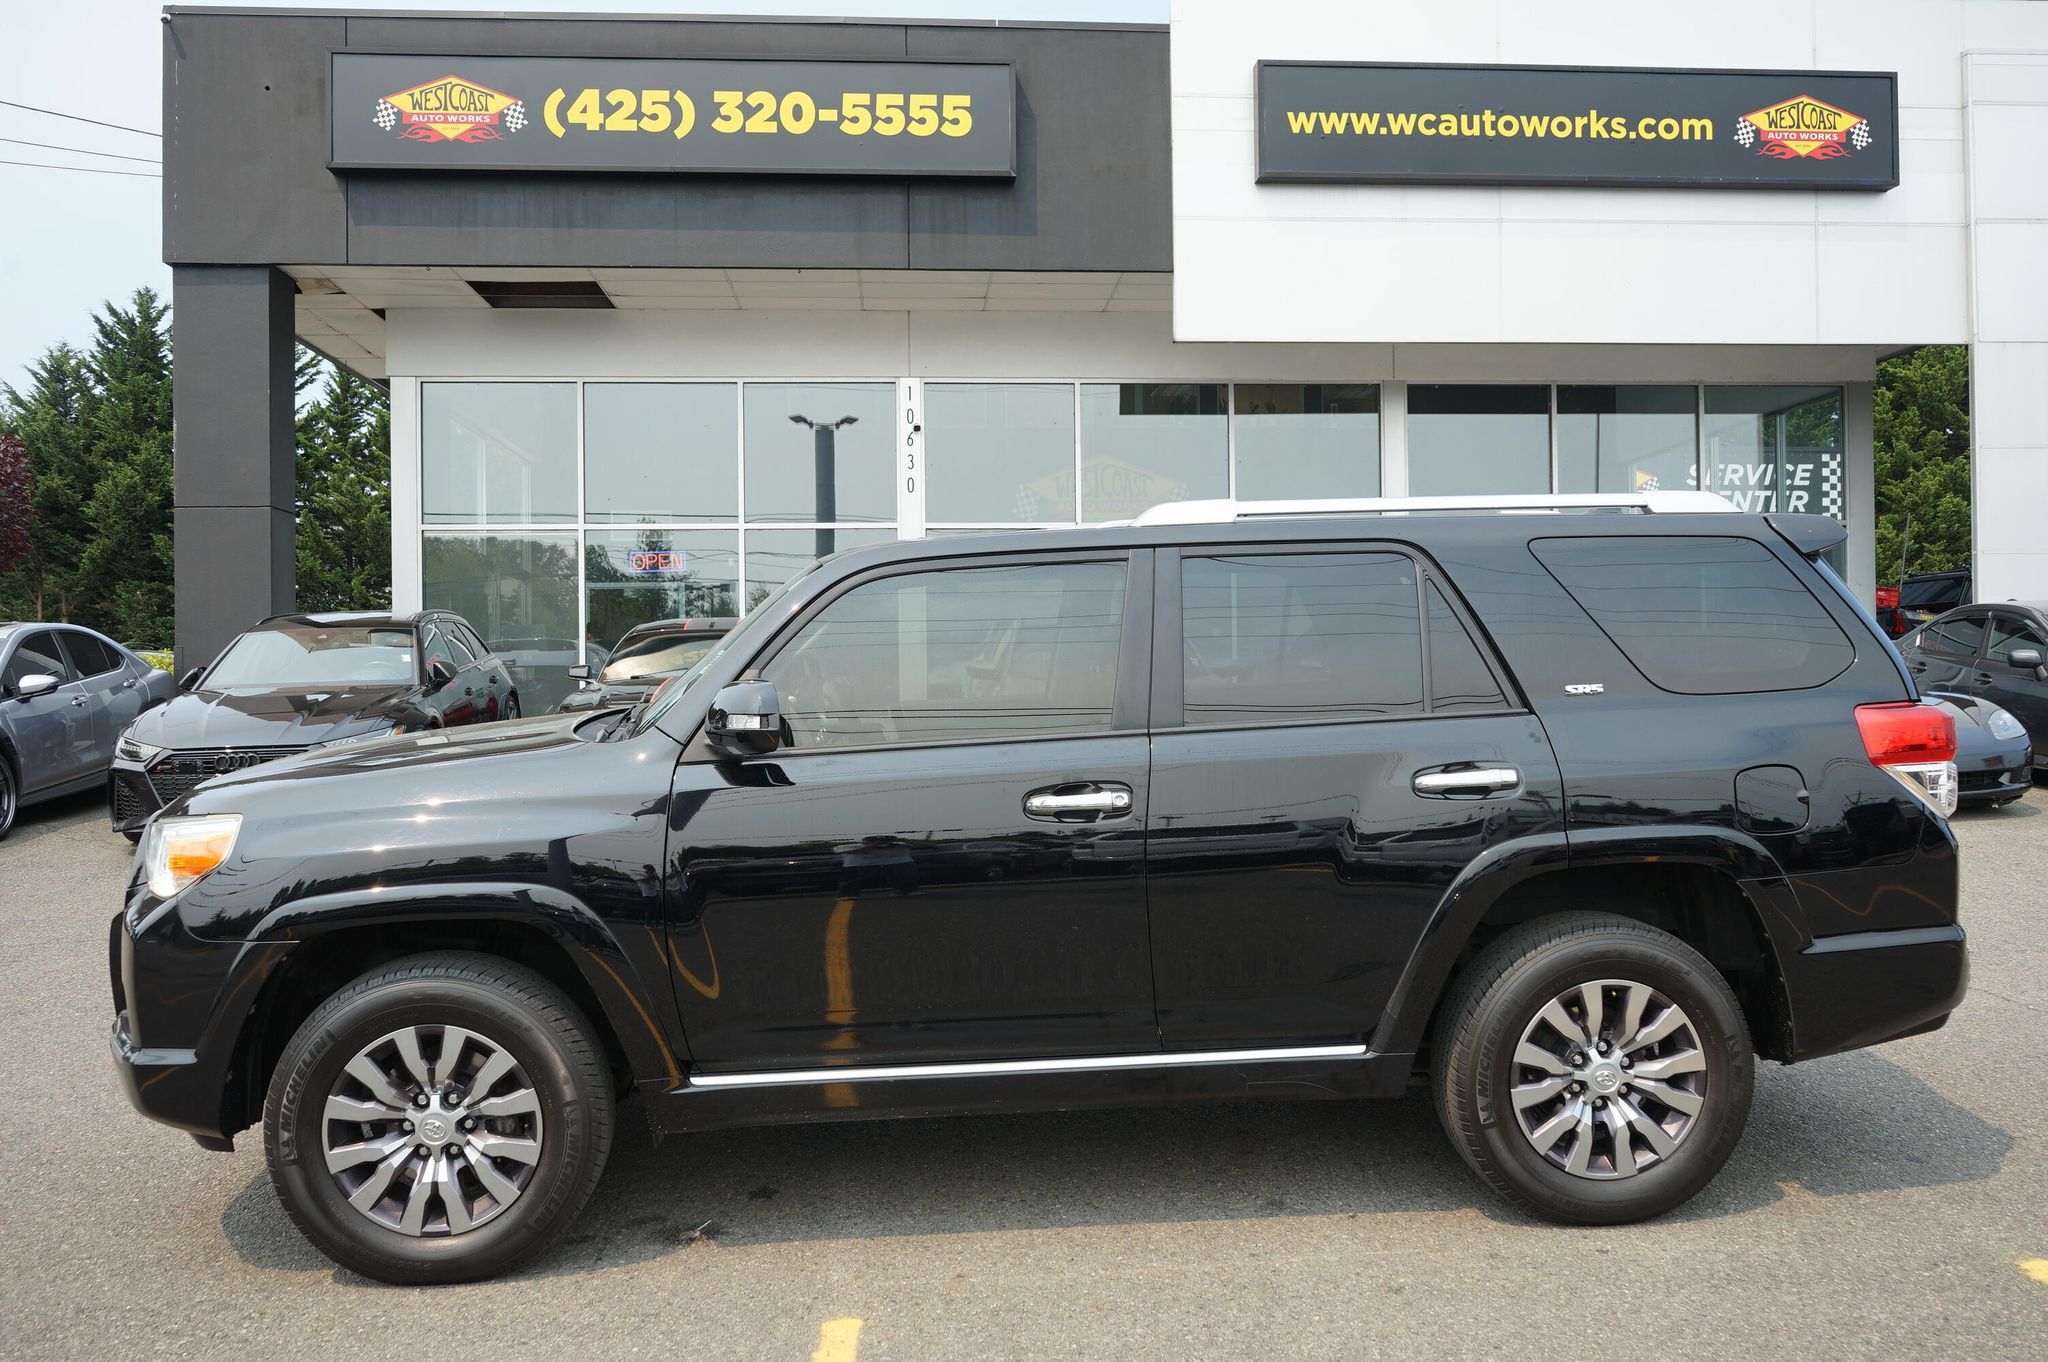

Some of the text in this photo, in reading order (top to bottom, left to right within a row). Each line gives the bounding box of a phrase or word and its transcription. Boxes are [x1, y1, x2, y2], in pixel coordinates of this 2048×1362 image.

[411, 115, 491, 123] AUTO WORKS
[543, 88, 972, 140] (425) 320-5555
[1287, 109, 1713, 140] www.wcautoworks.com
[1767, 132, 1839, 141] AUTO WORKS
[631, 553, 684, 570] OPEN
[1565, 683, 1604, 695] SR5
